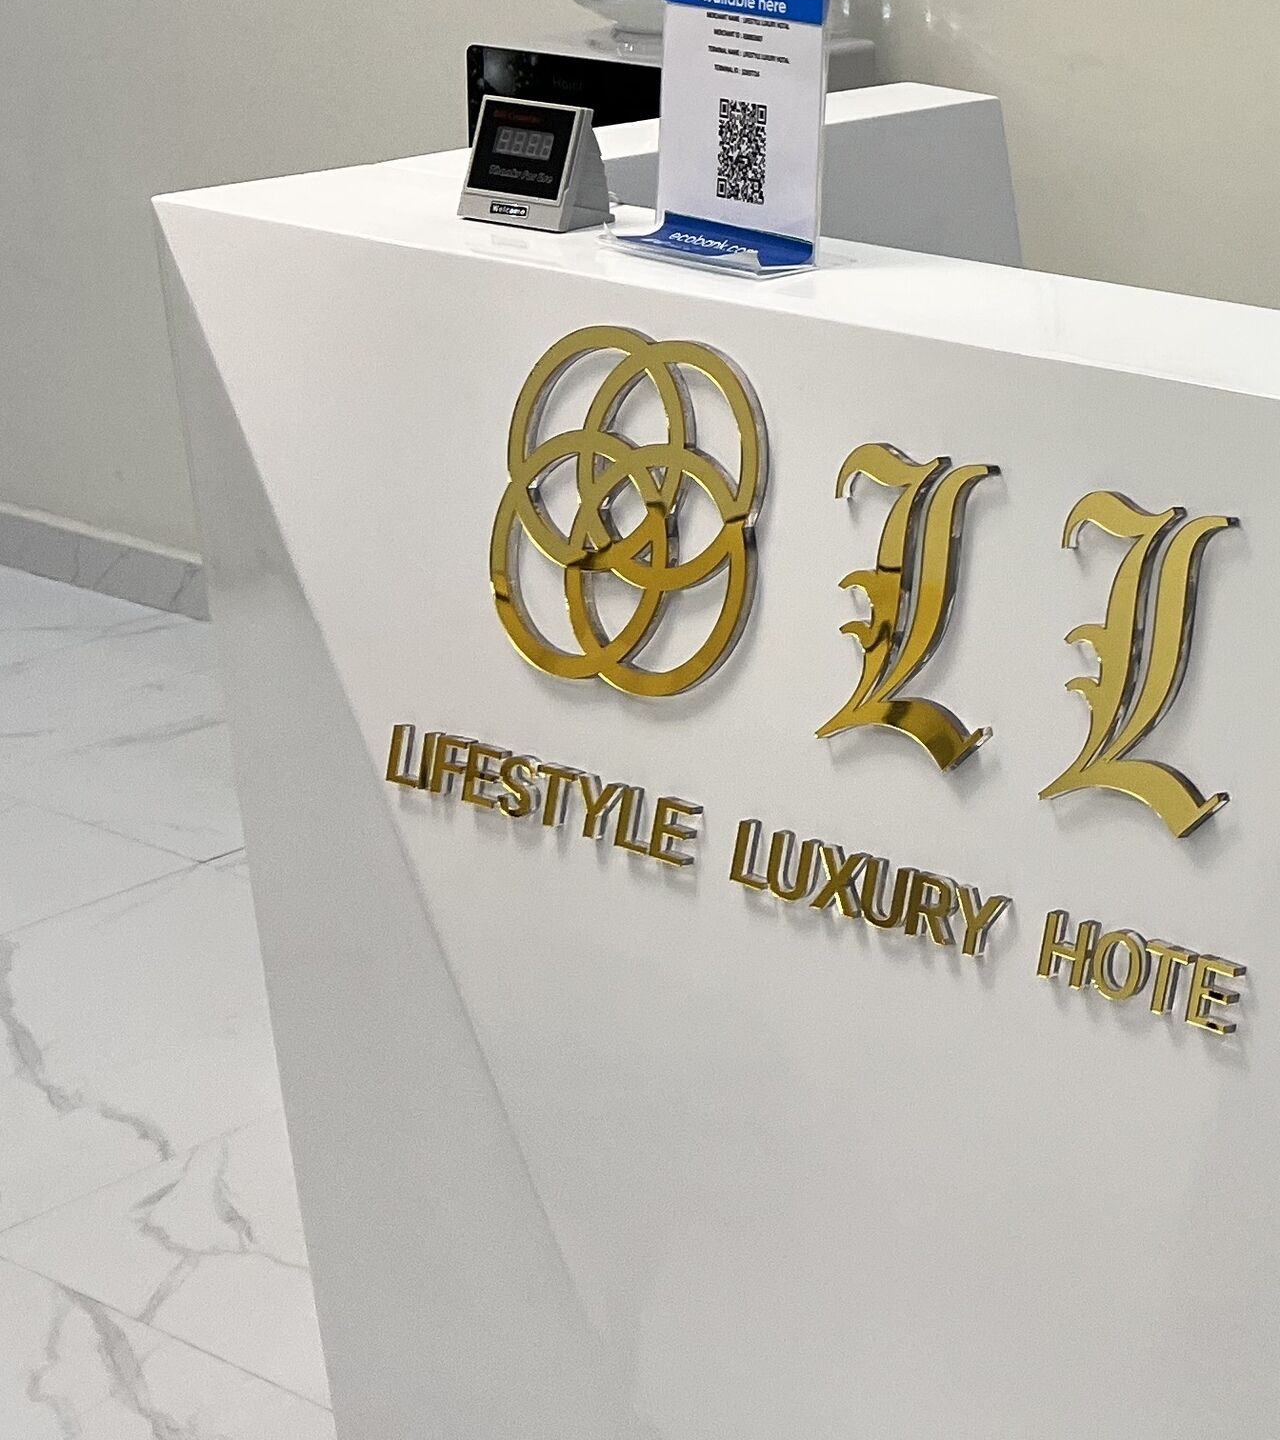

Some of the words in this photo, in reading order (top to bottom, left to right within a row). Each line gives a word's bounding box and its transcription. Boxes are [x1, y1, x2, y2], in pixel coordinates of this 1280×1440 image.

[492, 204, 526, 216] Welcome
[386, 722, 704, 867] LIFESTYLE
[729, 818, 1011, 957] LUXURY
[1036, 908, 1247, 1036] HOTE
